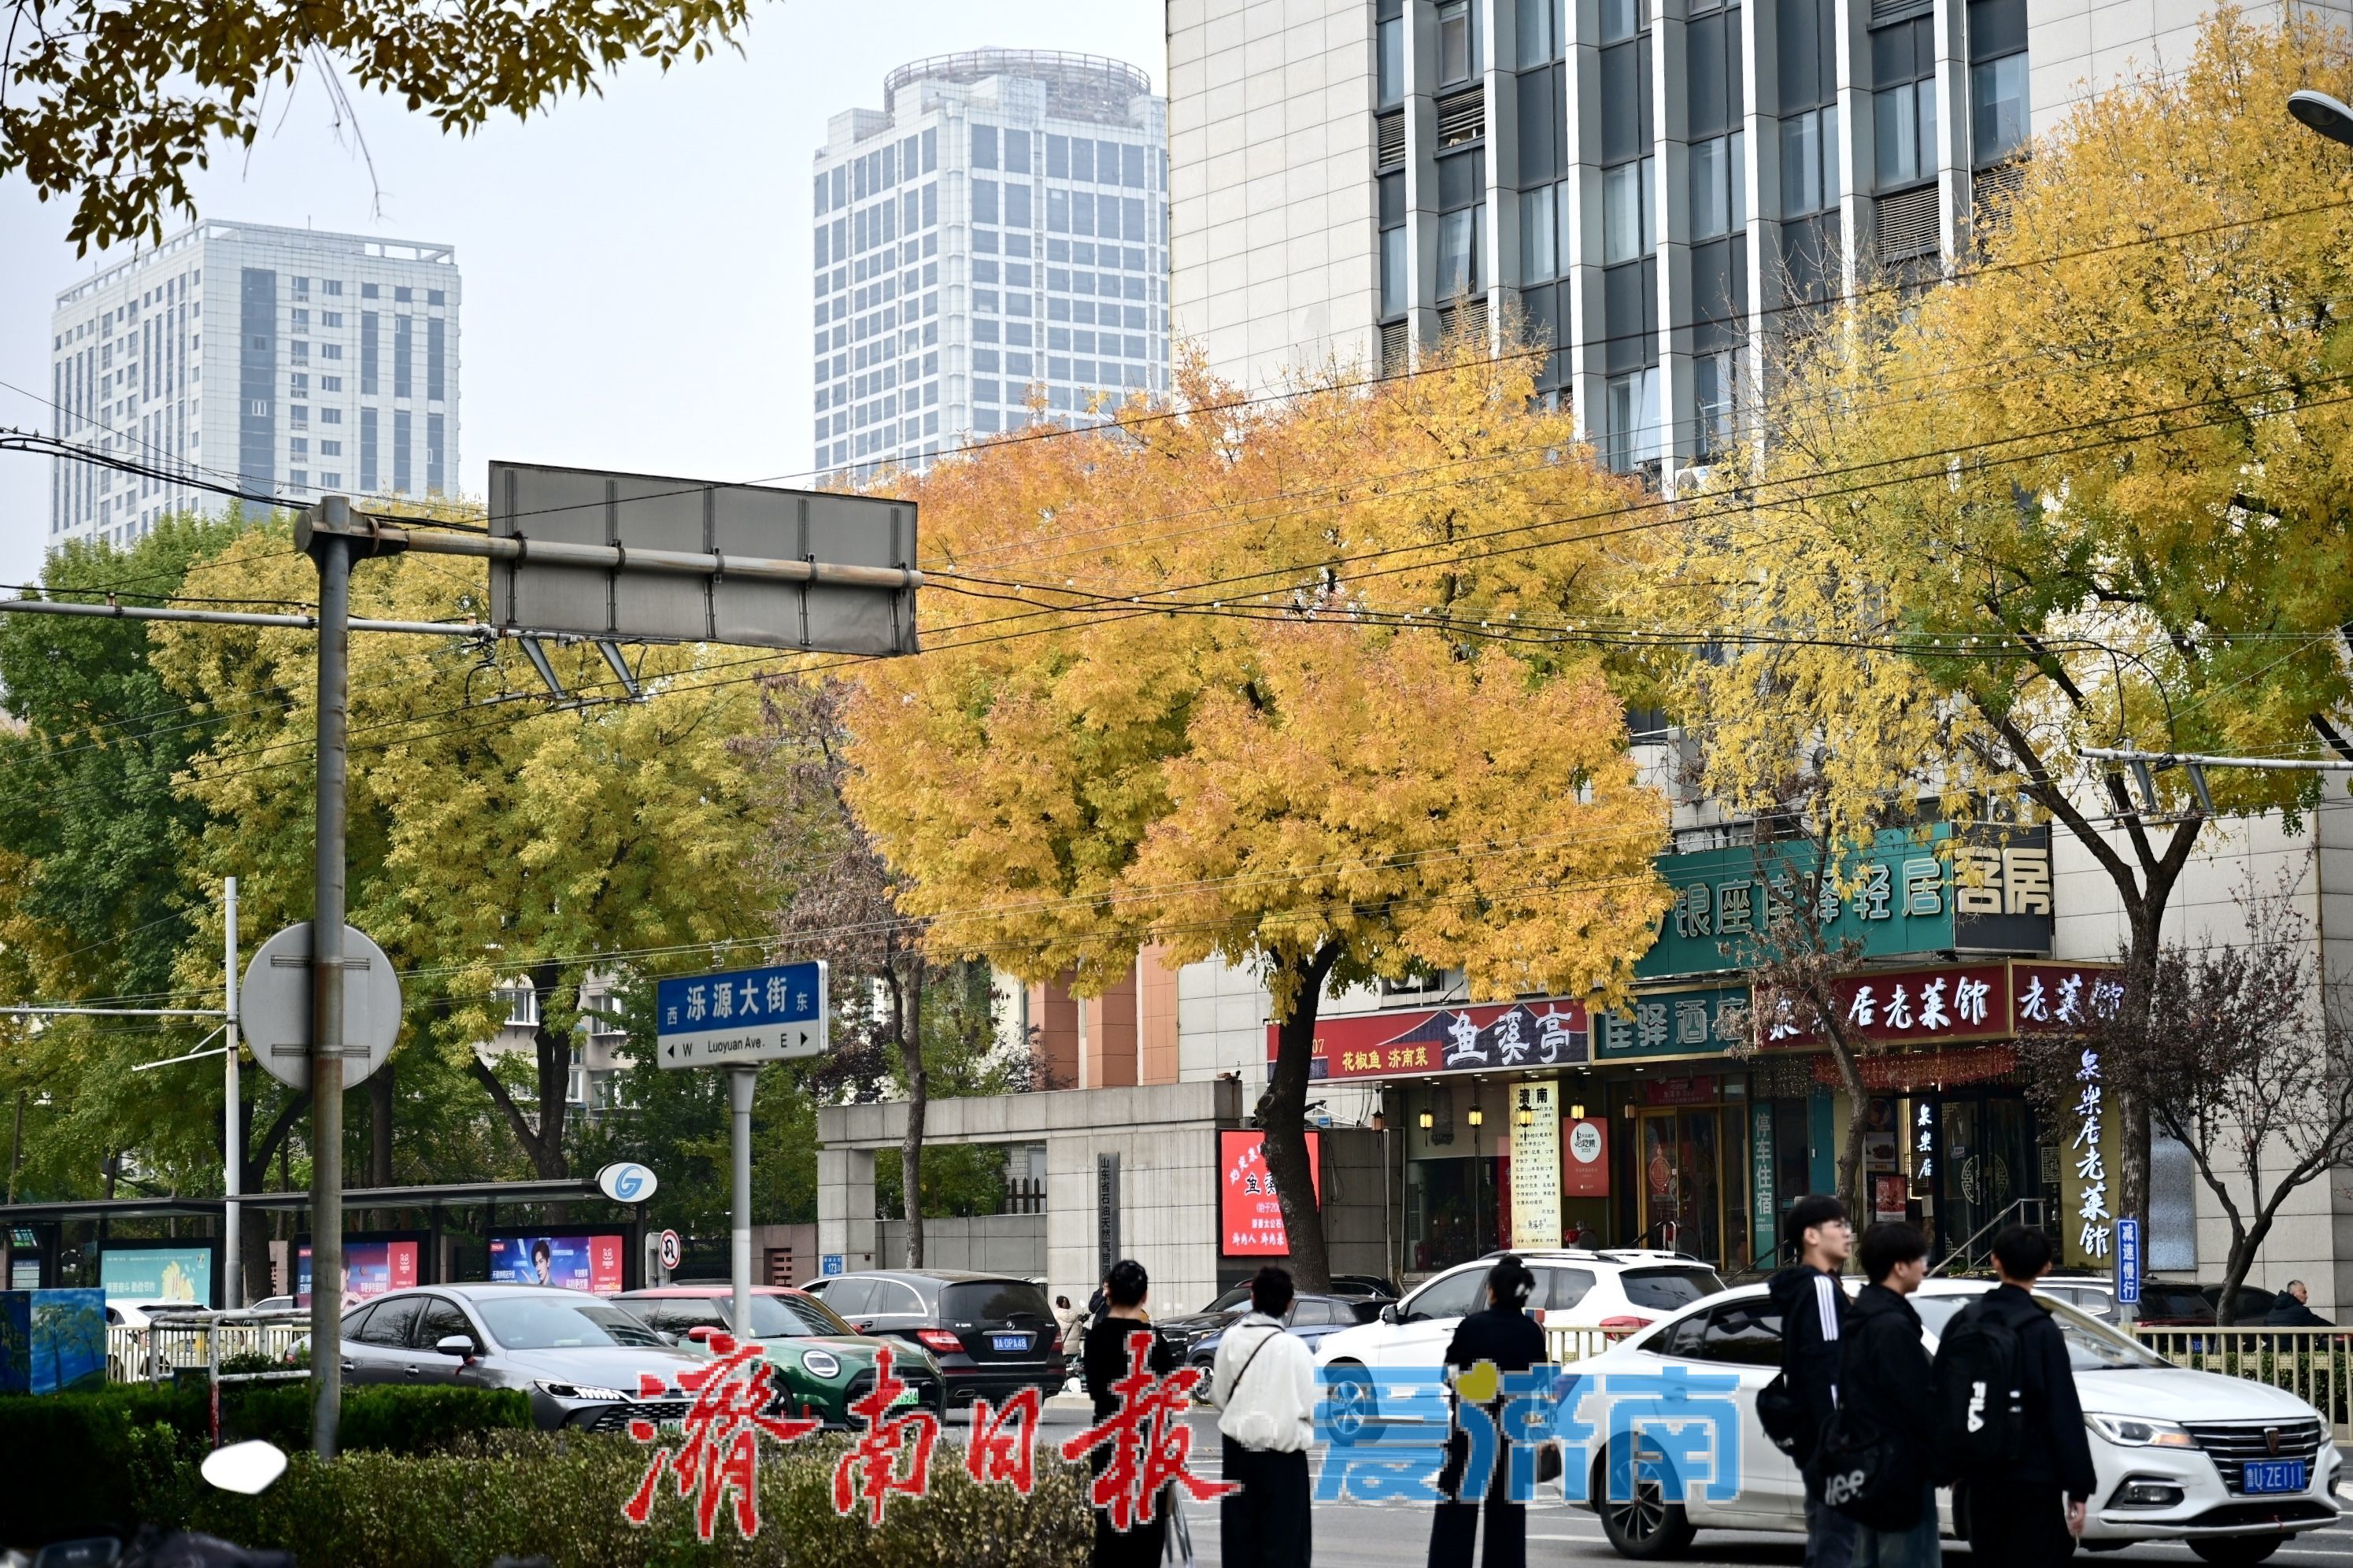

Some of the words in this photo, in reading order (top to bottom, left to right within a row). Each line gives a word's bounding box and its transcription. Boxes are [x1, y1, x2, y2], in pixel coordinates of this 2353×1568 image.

[667, 1007, 678, 1025] 西
[686, 977, 787, 1021] 泺源大街
[796, 992, 808, 1011] 东
[683, 1043, 693, 1056] W
[708, 1039, 742, 1054] Luoyuan
[780, 1034, 787, 1048] E
[1341, 1049, 1382, 1071] 花椒鱼
[1388, 1047, 1429, 1069] 济南菜
[1446, 1003, 1572, 1067] 鱼溪亭
[1755, 1112, 1772, 1215] 停车住宿
[2122, 1225, 2135, 1300] 减速慢行
[1968, 1381, 1986, 1433] FILA
